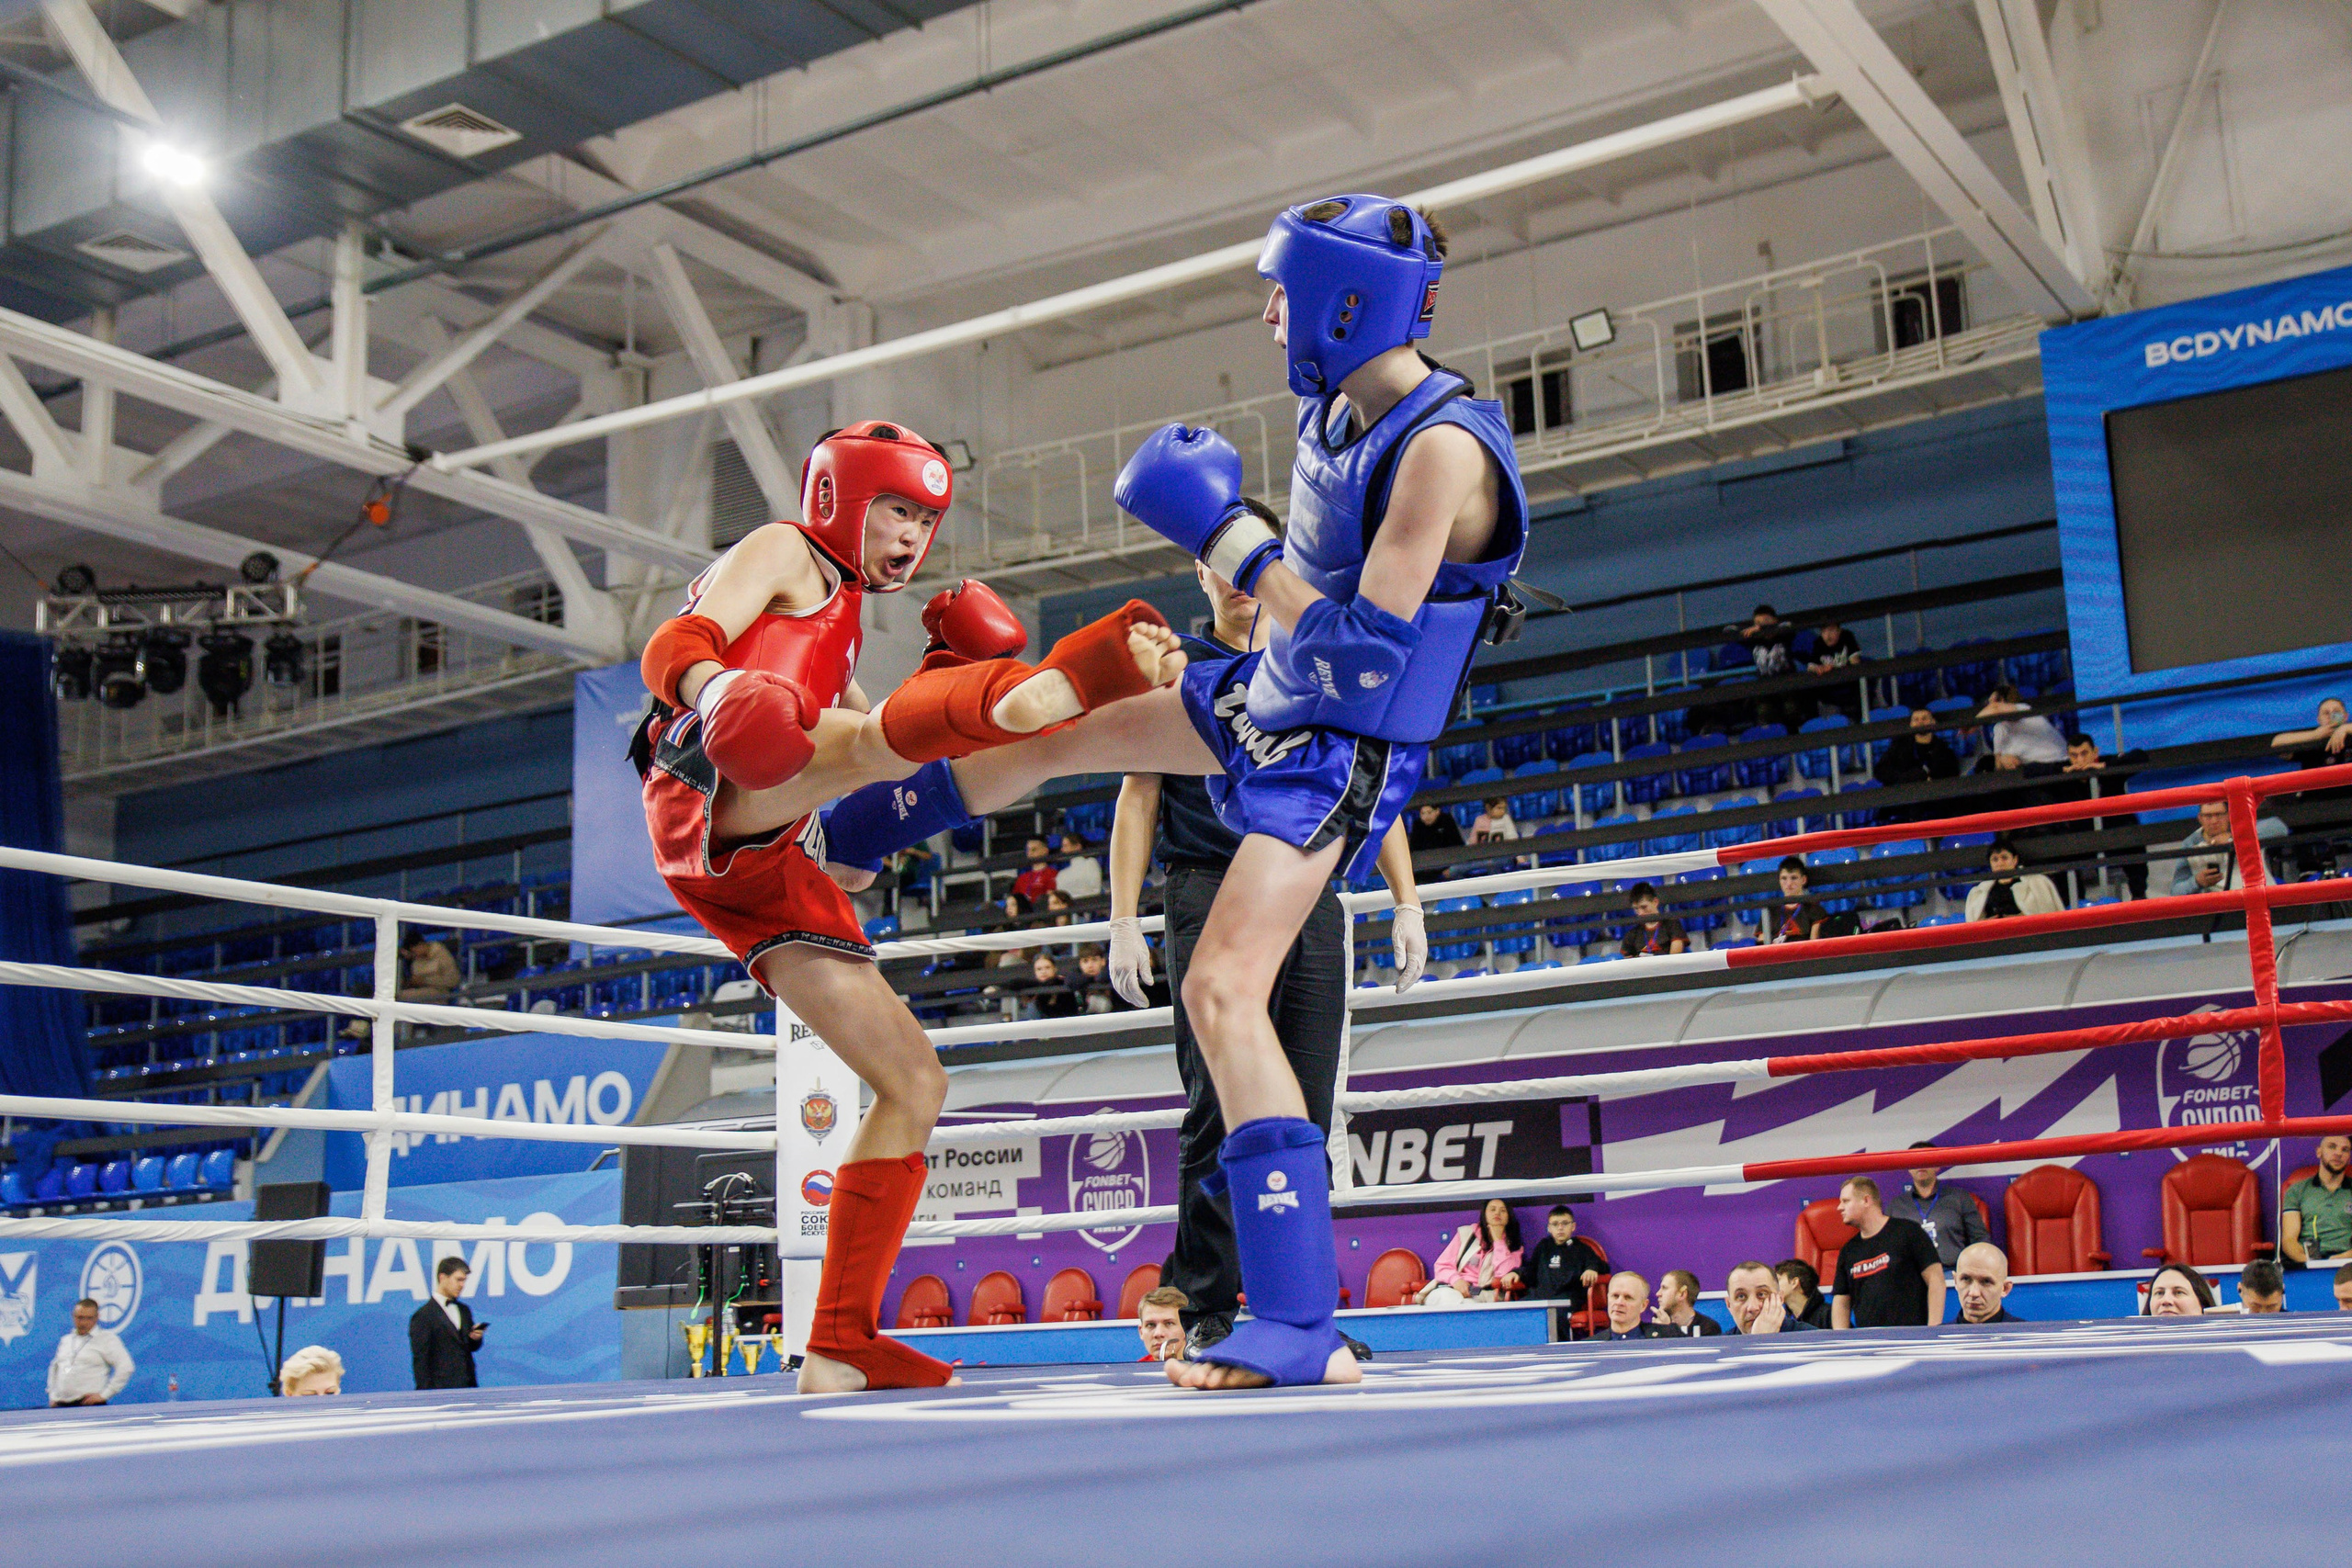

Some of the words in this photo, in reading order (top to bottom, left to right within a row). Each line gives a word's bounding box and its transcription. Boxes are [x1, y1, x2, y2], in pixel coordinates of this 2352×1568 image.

[791, 1023, 816, 1043] RE
[2183, 1085, 2254, 1104] FONBET
[945, 1147, 1023, 1168] России
[926, 1179, 1002, 1199] команд
[1084, 1173, 1132, 1188] FONBET
[193, 1212, 573, 1326] ДНАМО
